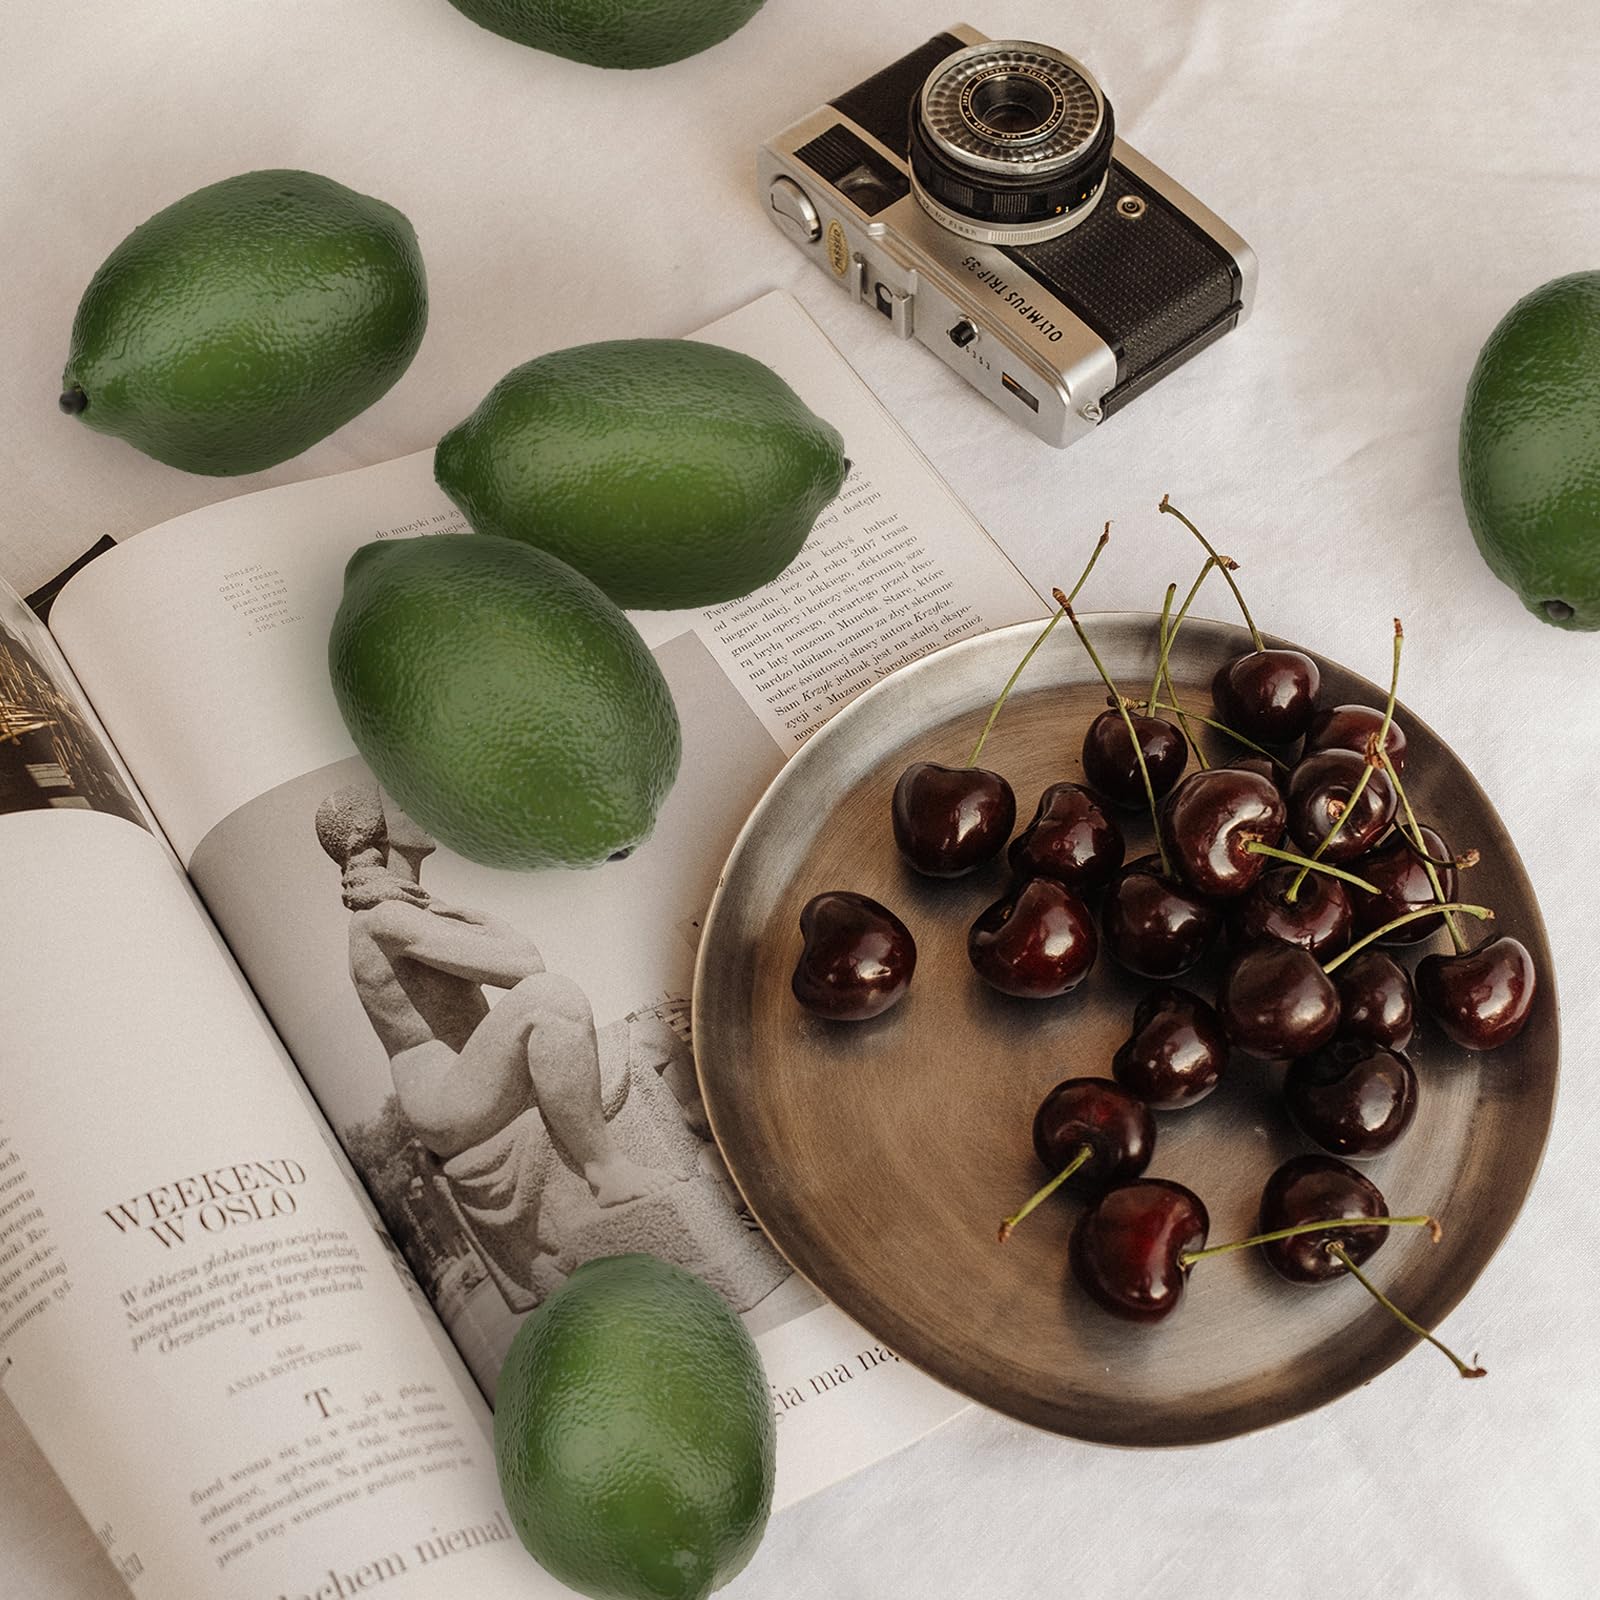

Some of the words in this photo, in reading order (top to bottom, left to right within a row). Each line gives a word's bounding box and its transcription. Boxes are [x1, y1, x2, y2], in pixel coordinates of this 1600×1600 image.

[962, 256, 981, 272] 35
[976, 270, 1008, 295] TRIP
[1004, 291, 1063, 342] OLYMPUS
[375, 530, 389, 540] do
[391, 519, 429, 536] muzyki
[432, 515, 446, 524] na
[843, 492, 881, 515] dostępu
[703, 593, 753, 620] Twierdza
[765, 560, 811, 589] zamykała
[820, 536, 854, 558] kiedyś
[863, 513, 899, 535] bulwar
[713, 620, 727, 633] od
[731, 596, 778, 622] wschodu,
[780, 581, 801, 595] lecz
[806, 570, 819, 582] od
[823, 556, 848, 573] roku
[851, 538, 877, 558] 2007
[881, 524, 908, 542] trasa
[720, 621, 759, 645] biegnie
[762, 604, 790, 623] dalej,
[793, 595, 806, 606] do
[808, 570, 854, 597] lekkiego,
[857, 535, 918, 571] efektownego
[731, 631, 771, 658] gmachu
[772, 614, 800, 634] opery
[805, 592, 841, 614] kończy
[843, 583, 859, 596] się
[906, 547, 925, 561] sza-
[740, 658, 754, 669] rą
[753, 640, 783, 661] bryłą
[785, 619, 826, 643] nowego,
[828, 588, 878, 620] otwartego
[880, 571, 909, 593] przed
[911, 559, 935, 574] dwo-
[748, 668, 766, 680] ma
[767, 654, 788, 669] laty
[791, 629, 835, 657] muzeum
[836, 605, 882, 631] Muncha.
[882, 586, 916, 605] Stare,
[916, 569, 944, 587] które
[755, 669, 793, 692] bardzo
[792, 647, 837, 673] lubiłam,
[837, 625, 874, 649] uznano
[875, 618, 887, 628] za
[888, 603, 910, 621] zbyt
[911, 580, 954, 607] skromne
[766, 682, 798, 704] wobec
[798, 654, 849, 687] światowej
[850, 638, 881, 660] sławy
[880, 620, 913, 642] autora
[913, 598, 954, 623] Krzyku.
[774, 699, 800, 716] Sam
[801, 679, 834, 703] Krzyk
[834, 659, 871, 686] jednak
[872, 647, 892, 665] jest
[894, 640, 908, 651] na
[910, 621, 940, 643] stałej
[940, 604, 972, 626] ekspo-
[785, 709, 811, 729] zycji
[813, 703, 824, 713] w
[826, 677, 872, 705] Muzeum
[873, 640, 941, 679] Narodowym,
[943, 614, 983, 641] również
[102, 1158, 306, 1233] WEEKEND
[148, 1214, 187, 1249] W
[199, 1187, 297, 1233] OSLO
[809, 1363, 854, 1395] ma
[855, 1345, 901, 1372] na
[413, 1510, 514, 1564] niemal
